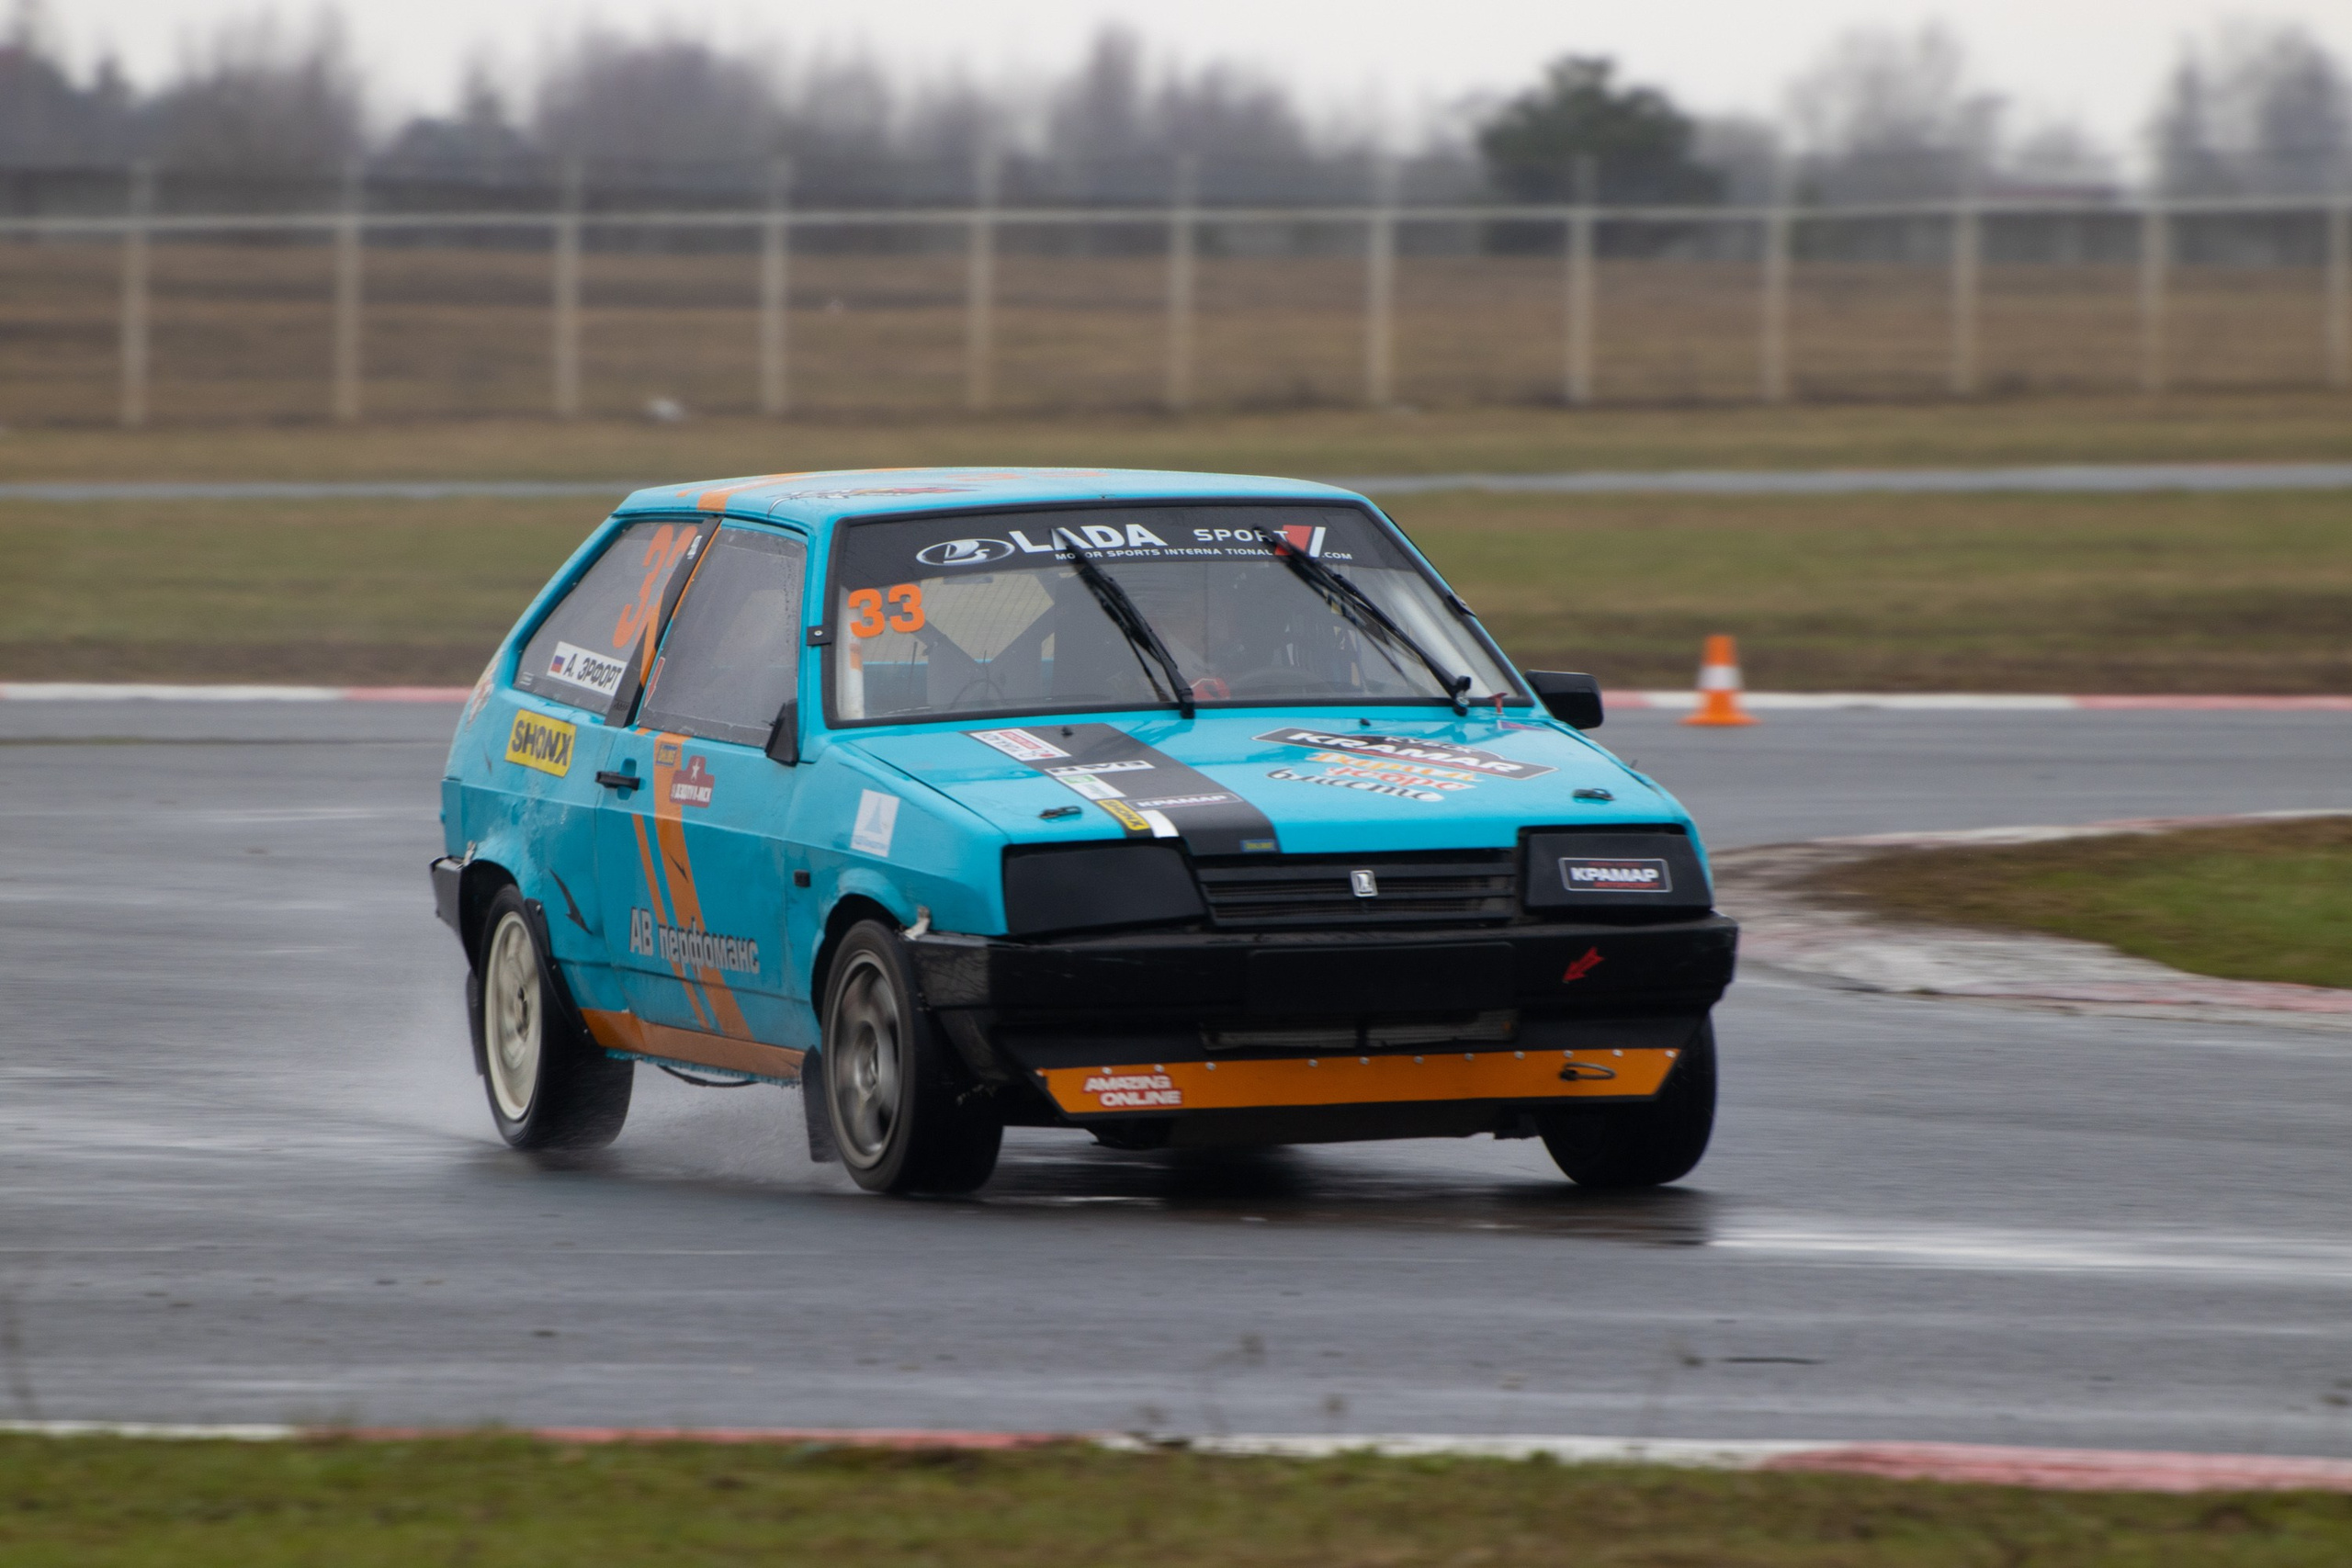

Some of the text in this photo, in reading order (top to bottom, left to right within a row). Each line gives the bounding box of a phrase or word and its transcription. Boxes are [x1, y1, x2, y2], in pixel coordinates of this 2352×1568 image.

[1009, 524, 1169, 553] LADA
[1055, 551, 1103, 560] MOOR
[1107, 548, 1160, 558] SPORTS
[848, 583, 925, 638] 33
[563, 653, 624, 691] А. ЭРФОРТ
[512, 719, 572, 767] SHONX
[1287, 732, 1524, 773] KRAMAR
[1570, 867, 1659, 882] КРАМАР
[629, 906, 761, 980] АВ перфоманс
[1100, 1090, 1182, 1107] ONLINE
